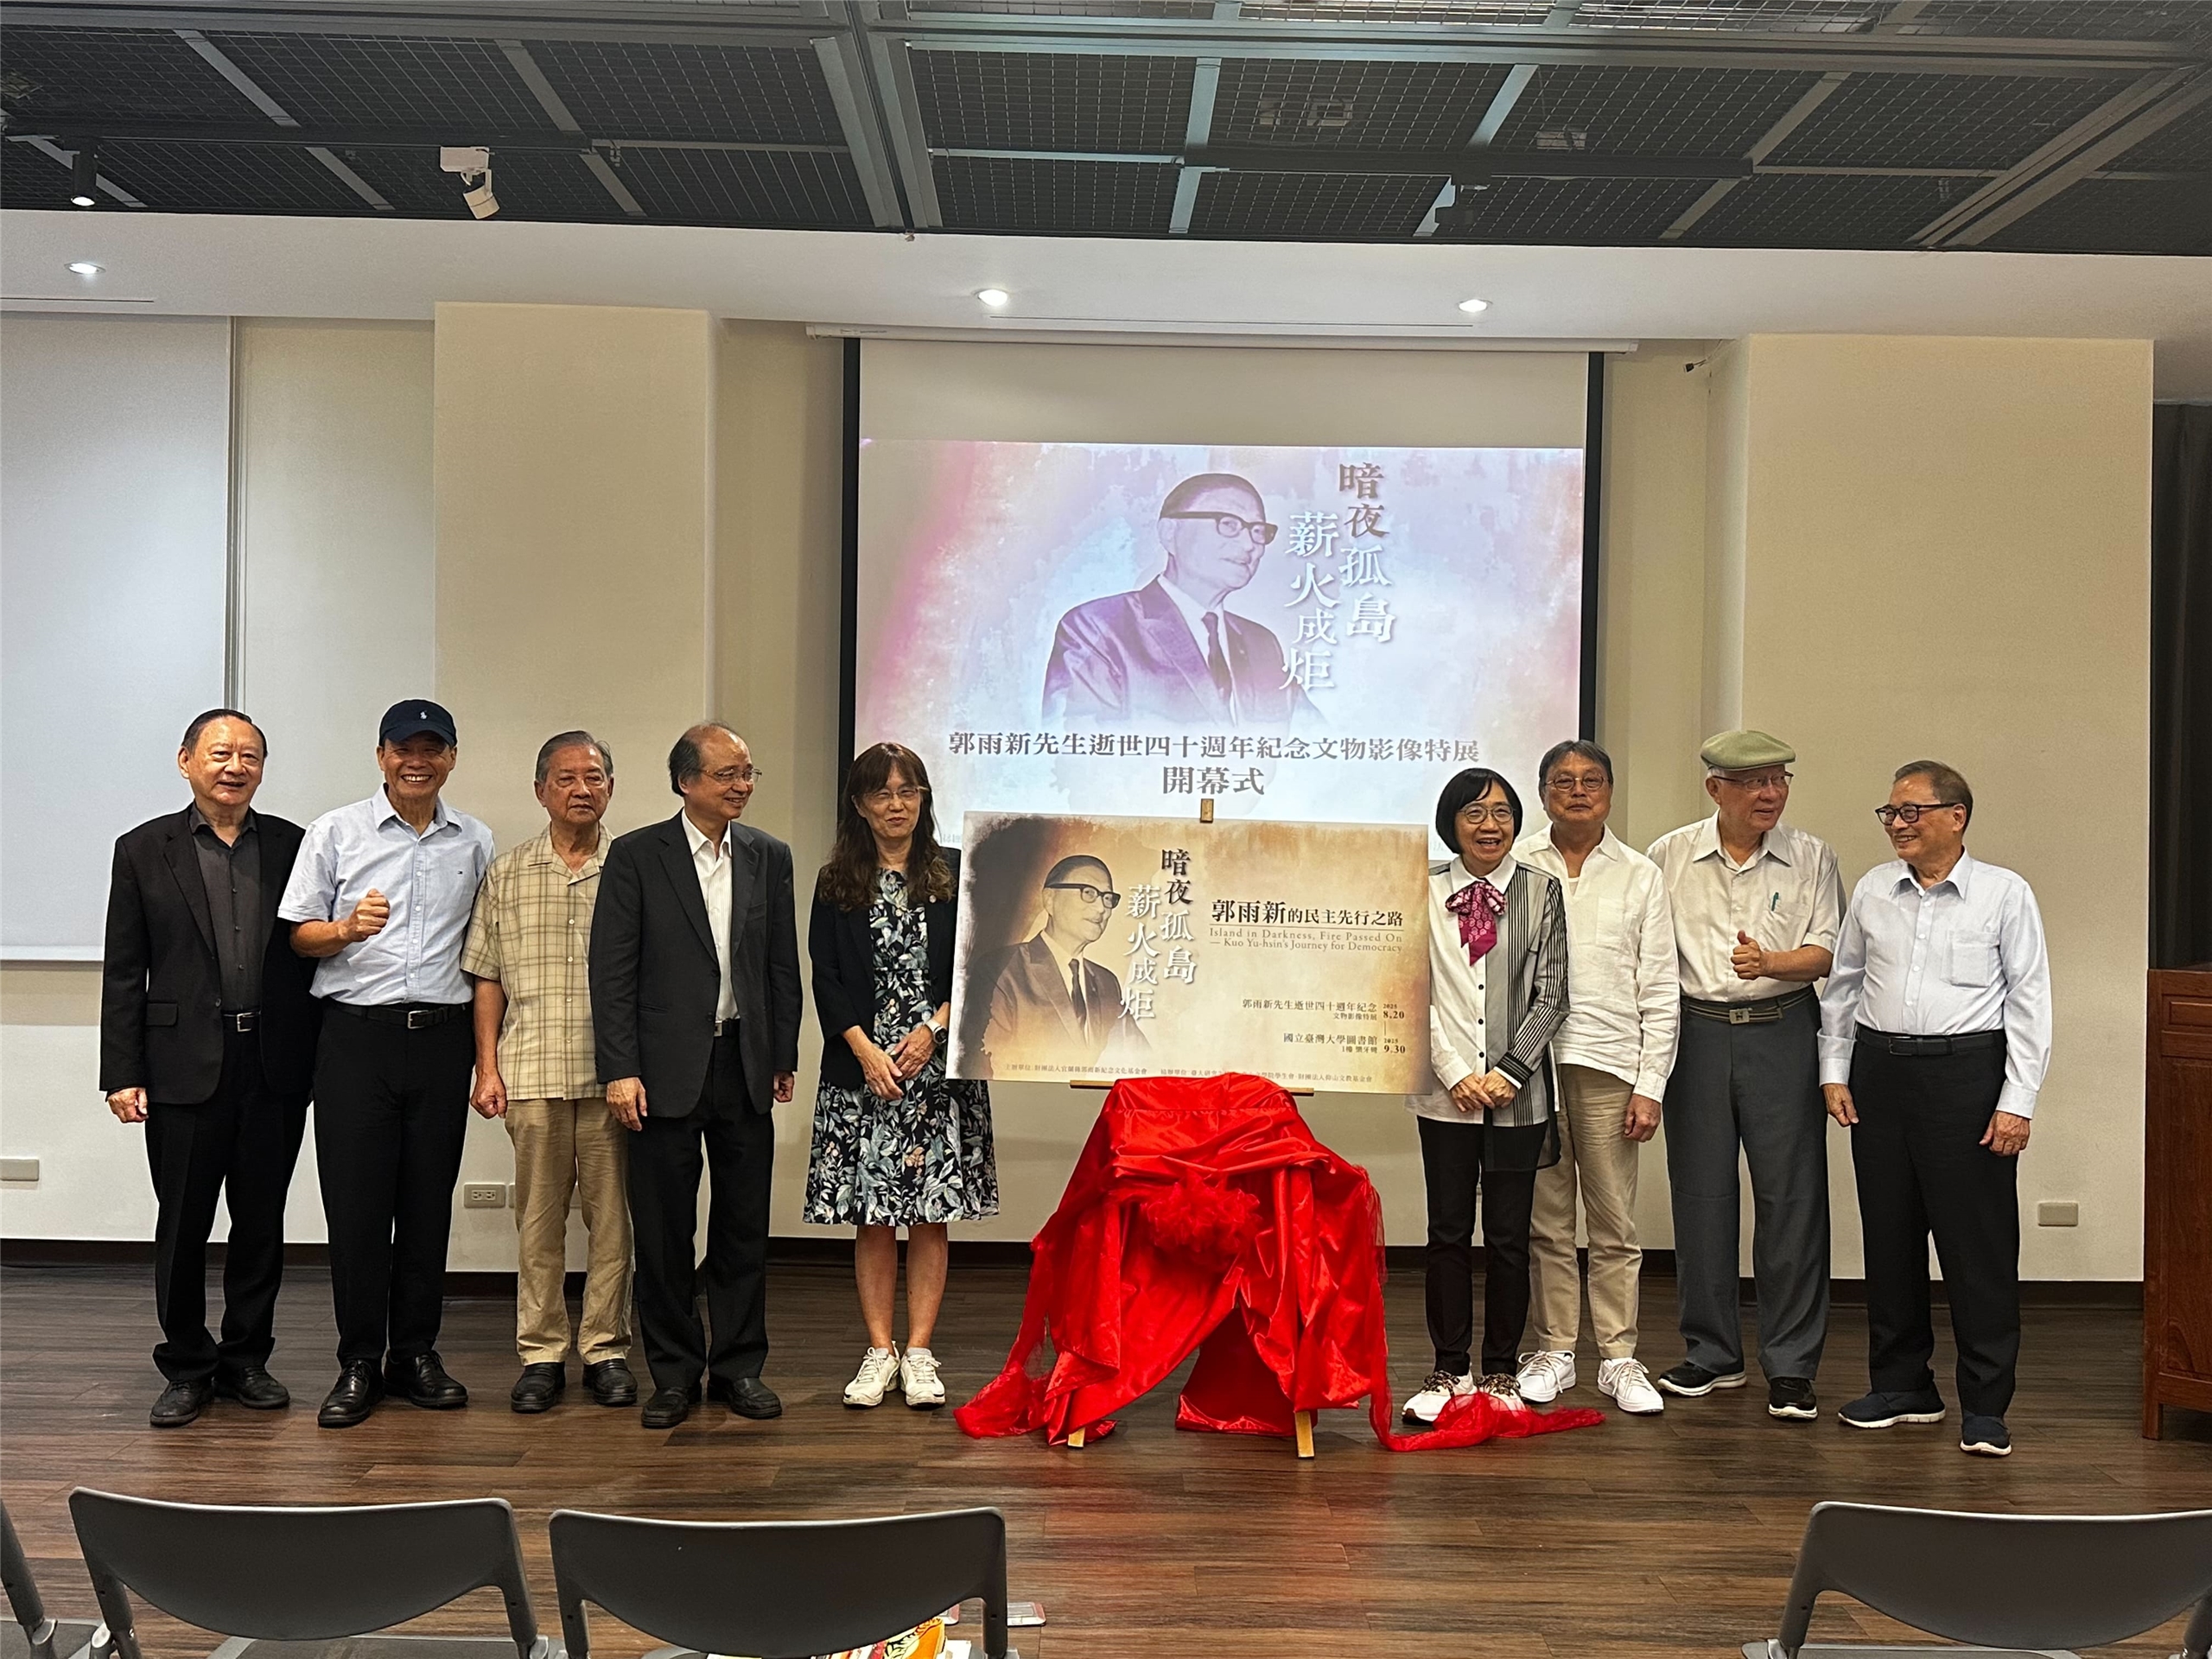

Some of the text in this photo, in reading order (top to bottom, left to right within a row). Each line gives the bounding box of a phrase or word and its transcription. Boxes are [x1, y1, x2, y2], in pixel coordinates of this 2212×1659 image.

[1339, 462, 1396, 642] 暗夜孤島
[1279, 512, 1341, 691] 薪火成炬
[949, 732, 1479, 762] 郭雨新先生逝世四十週年紀念文物影像特展
[1163, 766, 1264, 795] 開幕式
[1160, 849, 1197, 984] 暗夜孤島
[1211, 899, 1403, 926] 郭雨新的民主先行之路
[1210, 927, 1243, 938] Island
[1320, 931, 1341, 940] Fire
[1346, 932, 1381, 942] Passed
[1385, 933, 1402, 942] On
[1224, 938, 1244, 947] Kuo
[1290, 940, 1328, 952] Journey
[1331, 941, 1345, 950] for
[1348, 942, 1402, 954] Democracy
[1118, 884, 1160, 1020] 薪火成炬
[1382, 1010, 1405, 1020] 8.20
[1384, 1045, 1406, 1054] 9.30
